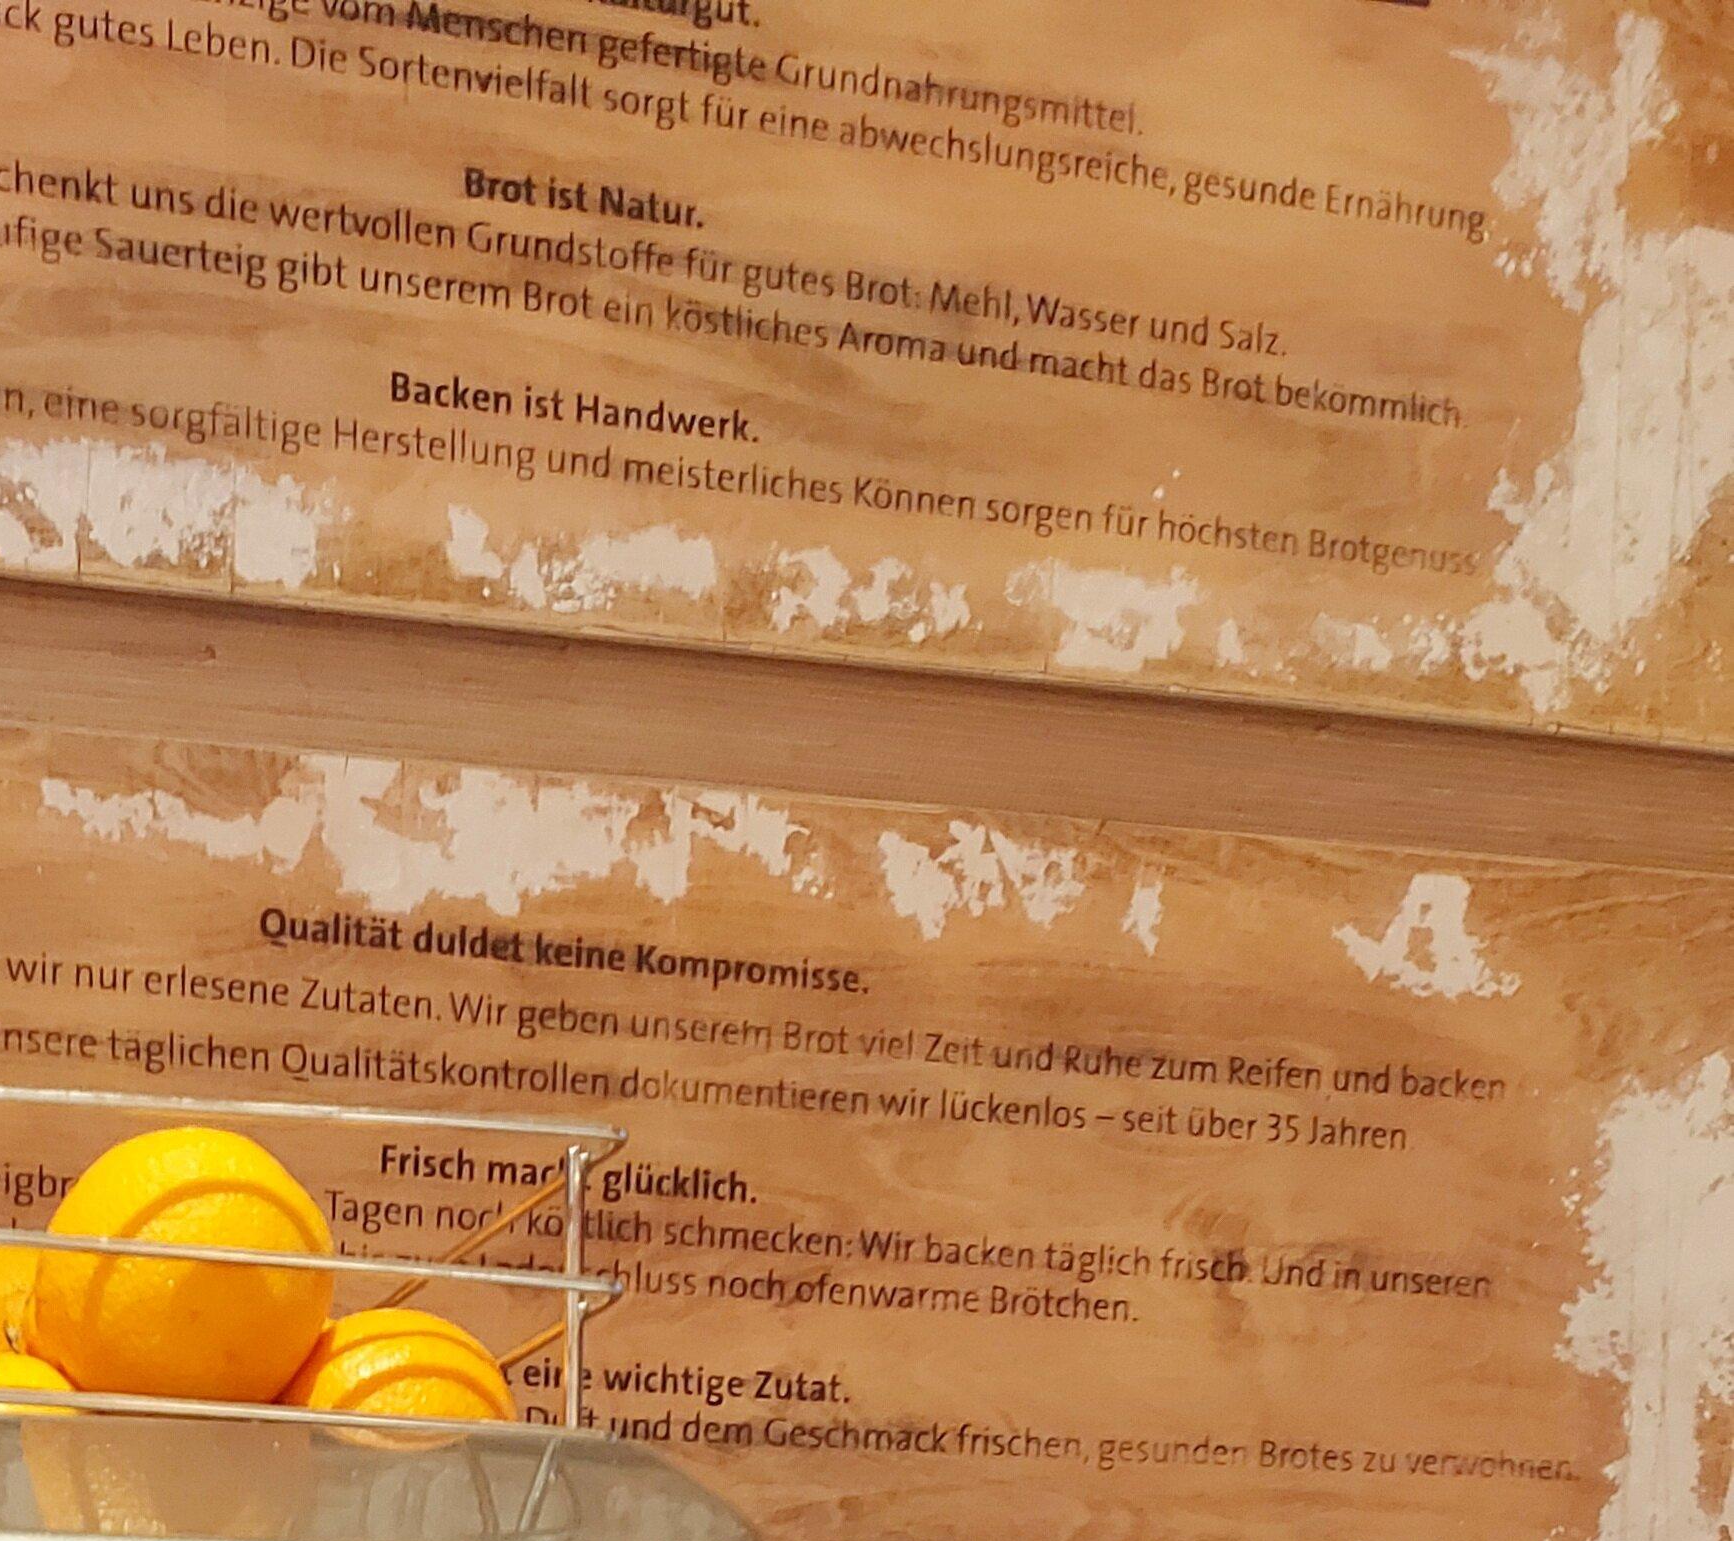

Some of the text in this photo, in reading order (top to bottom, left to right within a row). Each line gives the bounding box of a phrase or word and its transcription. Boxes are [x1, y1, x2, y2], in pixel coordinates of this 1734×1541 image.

[54, 9, 154, 48] gutes
[167, 18, 280, 65] Leben.
[291, 35, 347, 74] Die
[359, 45, 592, 109] Sortenvielfalt
[602, 89, 690, 130] sorgt
[701, 93, 749, 130] für
[759, 105, 829, 141] eine
[839, 113, 1176, 197] abwechslungsreiche,
[1183, 171, 1316, 210] gesunde
[405, 0, 1142, 135] Menschen gefertigte Grundnahrungsmittel.
[464, 166, 706, 230] Brot ist Natur.
[94, 227, 267, 288] Sauerteig
[276, 250, 348, 292] gibt
[360, 267, 511, 310] unserem
[524, 279, 593, 319] Brot
[603, 287, 653, 329] ein
[666, 292, 829, 348] köstliches
[833, 321, 949, 362] Aroma
[956, 340, 1019, 371] und
[1028, 351, 1129, 386] macht
[1138, 358, 1191, 394] das
[1202, 367, 1270, 404] Brot
[131, 183, 199, 215] uns
[205, 186, 260, 224] die
[269, 193, 460, 249] wertvollen
[467, 221, 679, 276] Grundstoffe
[681, 246, 737, 283] für
[743, 262, 835, 298] gutes
[846, 269, 921, 309] Brot:
[929, 280, 1020, 327] Mehl,
[1026, 293, 1140, 338] Wasser
[1149, 315, 1209, 347] und
[1219, 320, 1286, 356] Salz.
[391, 370, 759, 443] Backen ist Handwerk.
[43, 386, 124, 425] eine
[130, 401, 321, 455] sorgfältige
[335, 416, 536, 481] Herstellung
[548, 445, 612, 479] und
[623, 456, 843, 504] meisterliches
[854, 476, 976, 520] Können
[985, 499, 1092, 538] sorgen
[1102, 503, 1149, 538] für
[1158, 508, 1298, 556] höchsten
[259, 907, 869, 994] Qualität duldet keine Kompromisse.
[6, 952, 63, 986] wir
[75, 963, 134, 994] nur
[144, 964, 289, 1007] erlesene
[300, 976, 441, 1021] Zutaten.
[449, 991, 508, 1027] Wir
[517, 999, 619, 1039] geben
[626, 1014, 772, 1052] unserem
[783, 1021, 849, 1055] Brot
[857, 1029, 913, 1059] viel
[924, 1033, 984, 1066] Zeit
[989, 1042, 1054, 1071] und
[1062, 1045, 1146, 1078] Ruhe
[1147, 1050, 1217, 1083] zum
[1333, 1063, 1391, 1094] und
[1401, 1064, 1506, 1101] backen
[107, 1031, 269, 1075] täglichen
[282, 1038, 610, 1099] Qualitätskontrollen
[619, 1067, 869, 1115] dokumentieren
[878, 1088, 931, 1119] wir
[940, 1088, 1086, 1129] lückenlos
[1123, 1106, 1178, 1135] seit
[1187, 1107, 1258, 1140] über
[1267, 1113, 1300, 1144] 35
[324, 1189, 423, 1234] Tagen
[664, 1215, 853, 1259] schmecken:
[858, 1229, 916, 1263] Wir
[922, 1232, 1035, 1270] backen
[1042, 1242, 1151, 1283] täglich
[1261, 1249, 1326, 1288] Und
[1332, 1254, 1362, 1290] in
[1370, 1271, 1492, 1298] unseren
[680, 1409, 1395, 1473] dem Geschmack frischen, gesunden Brotes zu
